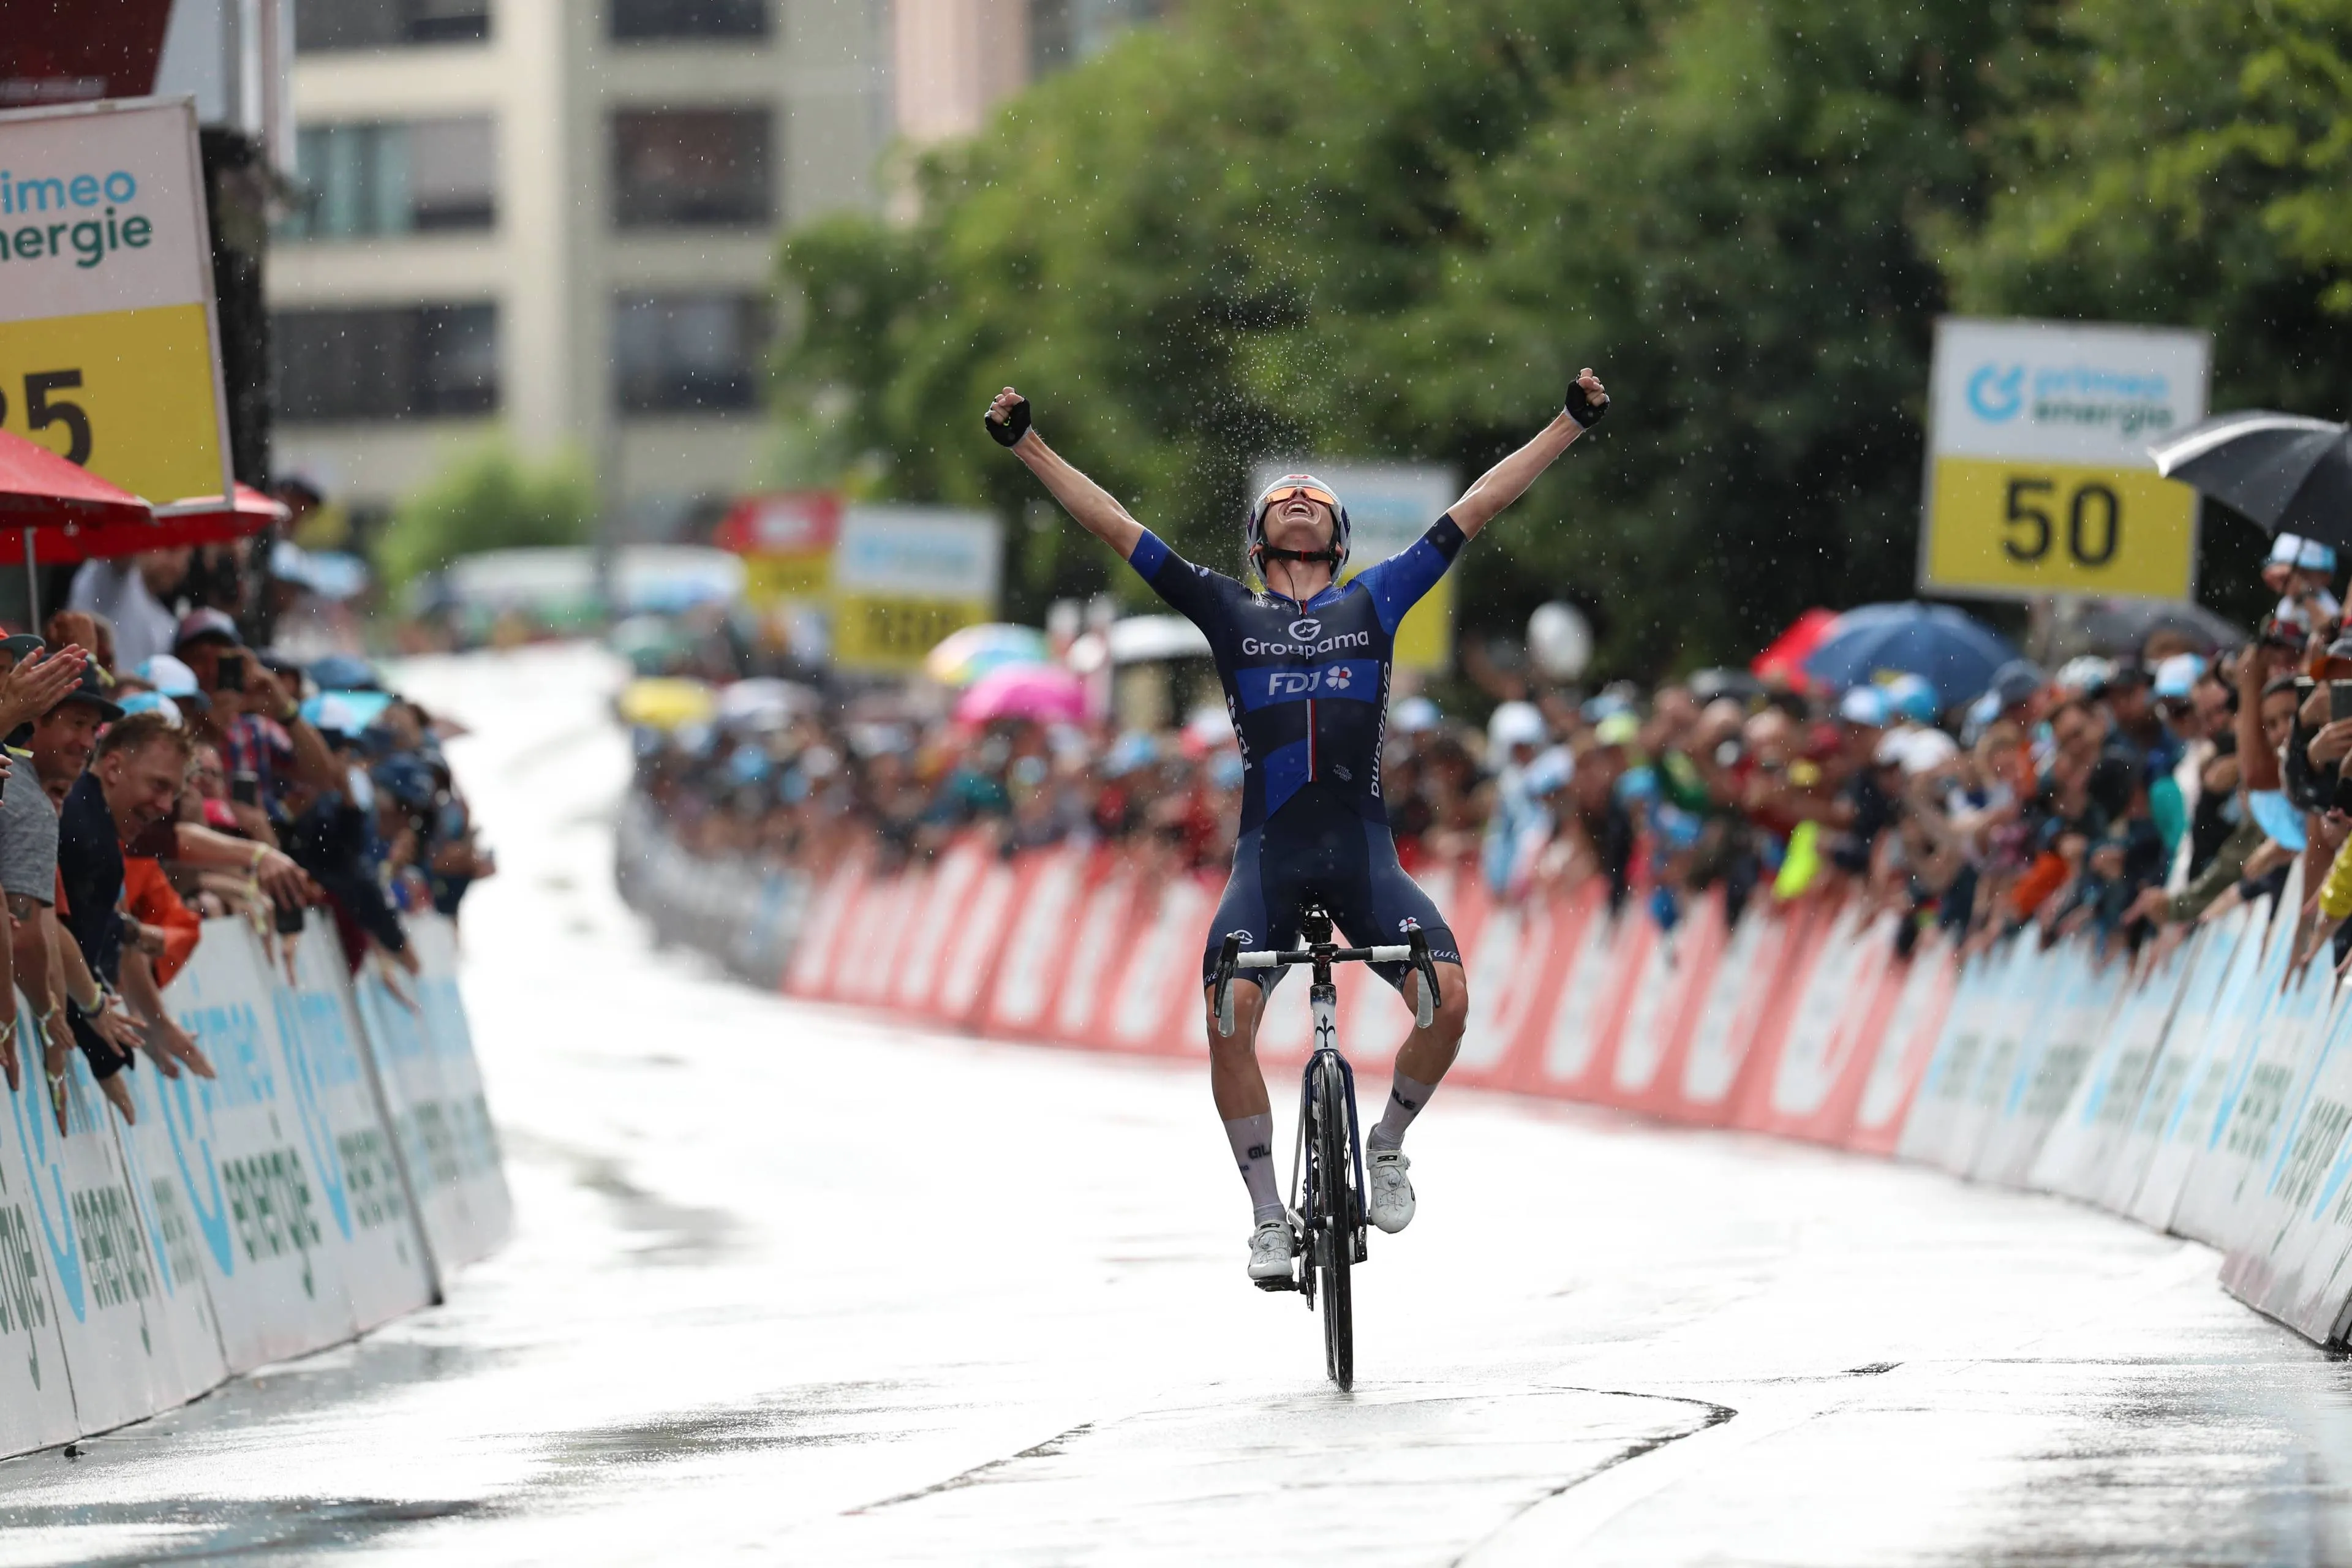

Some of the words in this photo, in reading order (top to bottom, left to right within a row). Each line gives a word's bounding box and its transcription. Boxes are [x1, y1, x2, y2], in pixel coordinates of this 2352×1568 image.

[0, 369, 92, 467] 5
[2003, 476, 2123, 568] 50
[1242, 631, 1369, 659] Groupama
[1268, 671, 1321, 695] FDJ
[1371, 662, 1390, 797] Groupama
